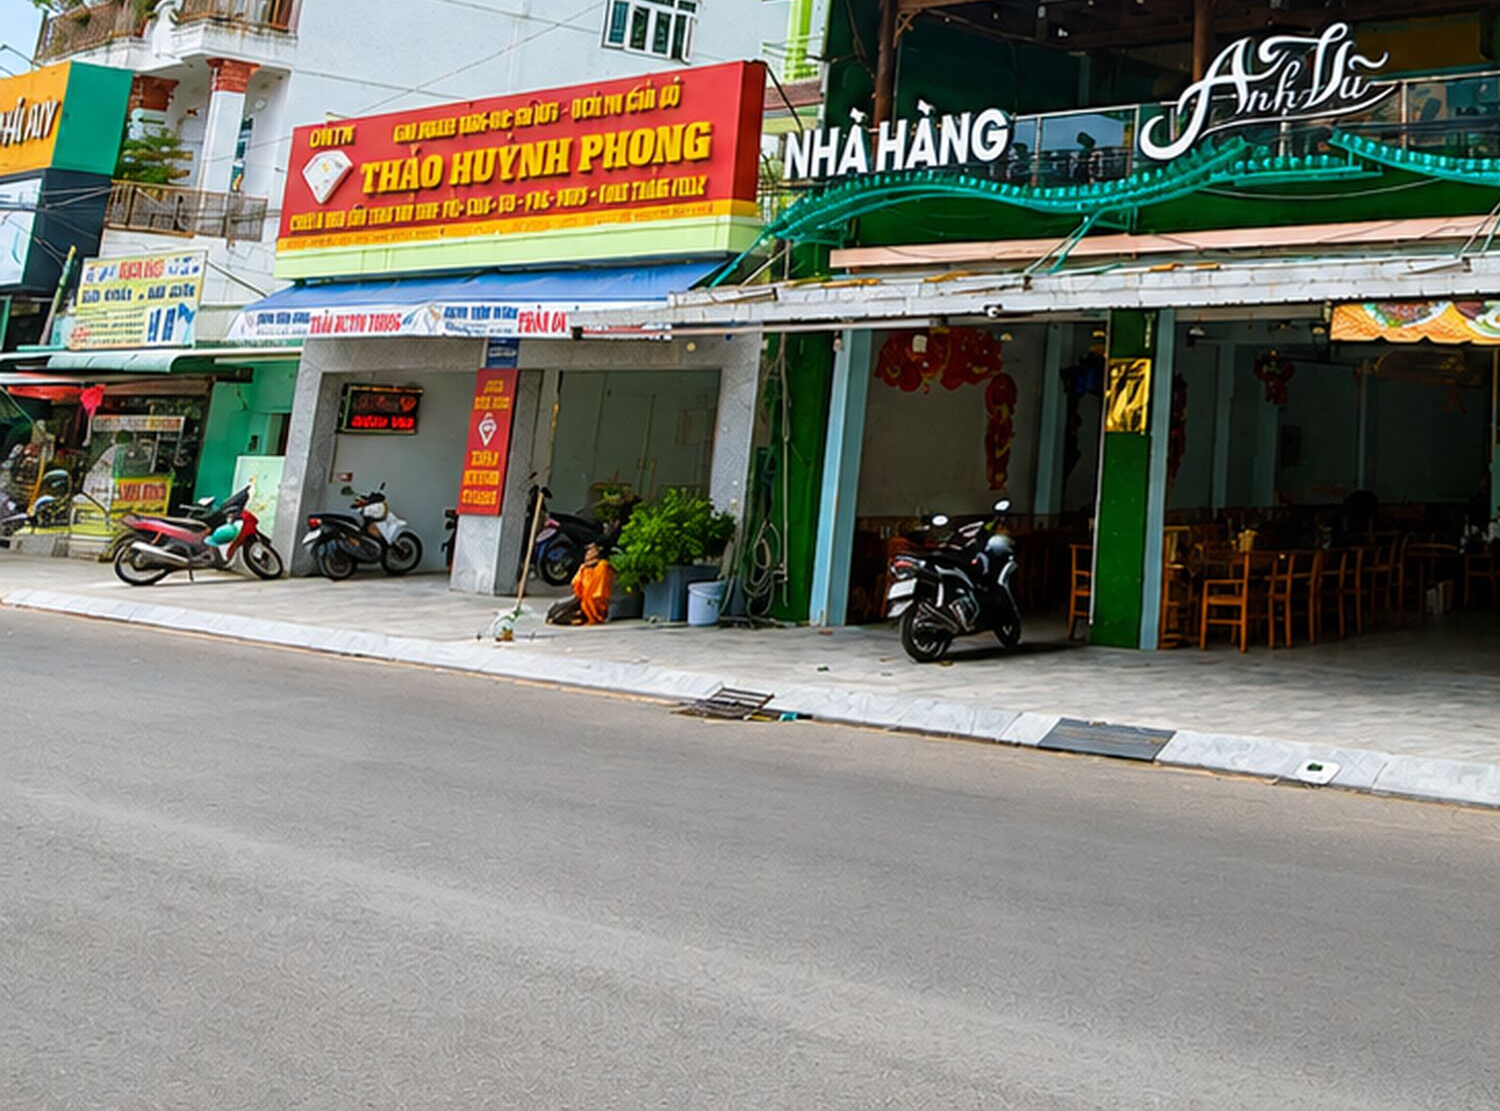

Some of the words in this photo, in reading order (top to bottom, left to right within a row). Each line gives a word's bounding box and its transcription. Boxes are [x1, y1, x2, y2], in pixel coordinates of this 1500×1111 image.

[577, 120, 713, 172] PHONG
[782, 106, 869, 181] NHÀ
[875, 98, 1010, 174] HÀNG
